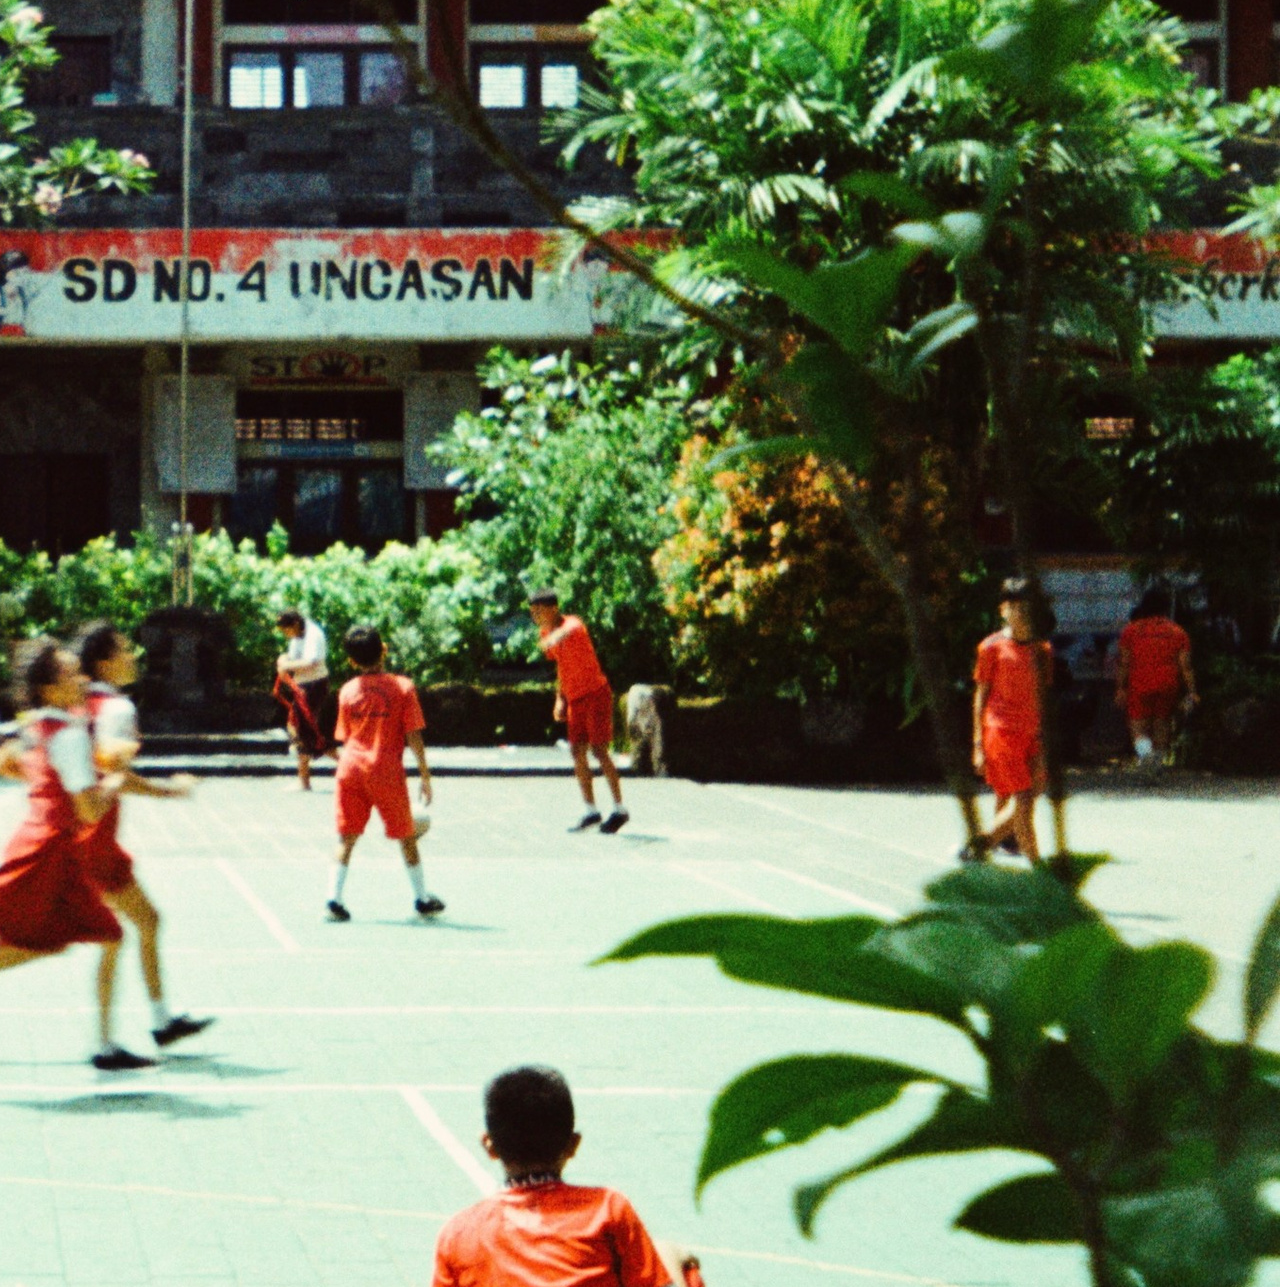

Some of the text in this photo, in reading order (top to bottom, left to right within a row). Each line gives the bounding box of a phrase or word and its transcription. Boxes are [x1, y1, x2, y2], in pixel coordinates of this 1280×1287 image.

[63, 257, 137, 302] SD
[153, 259, 225, 302] NO.
[236, 260, 266, 302] 4
